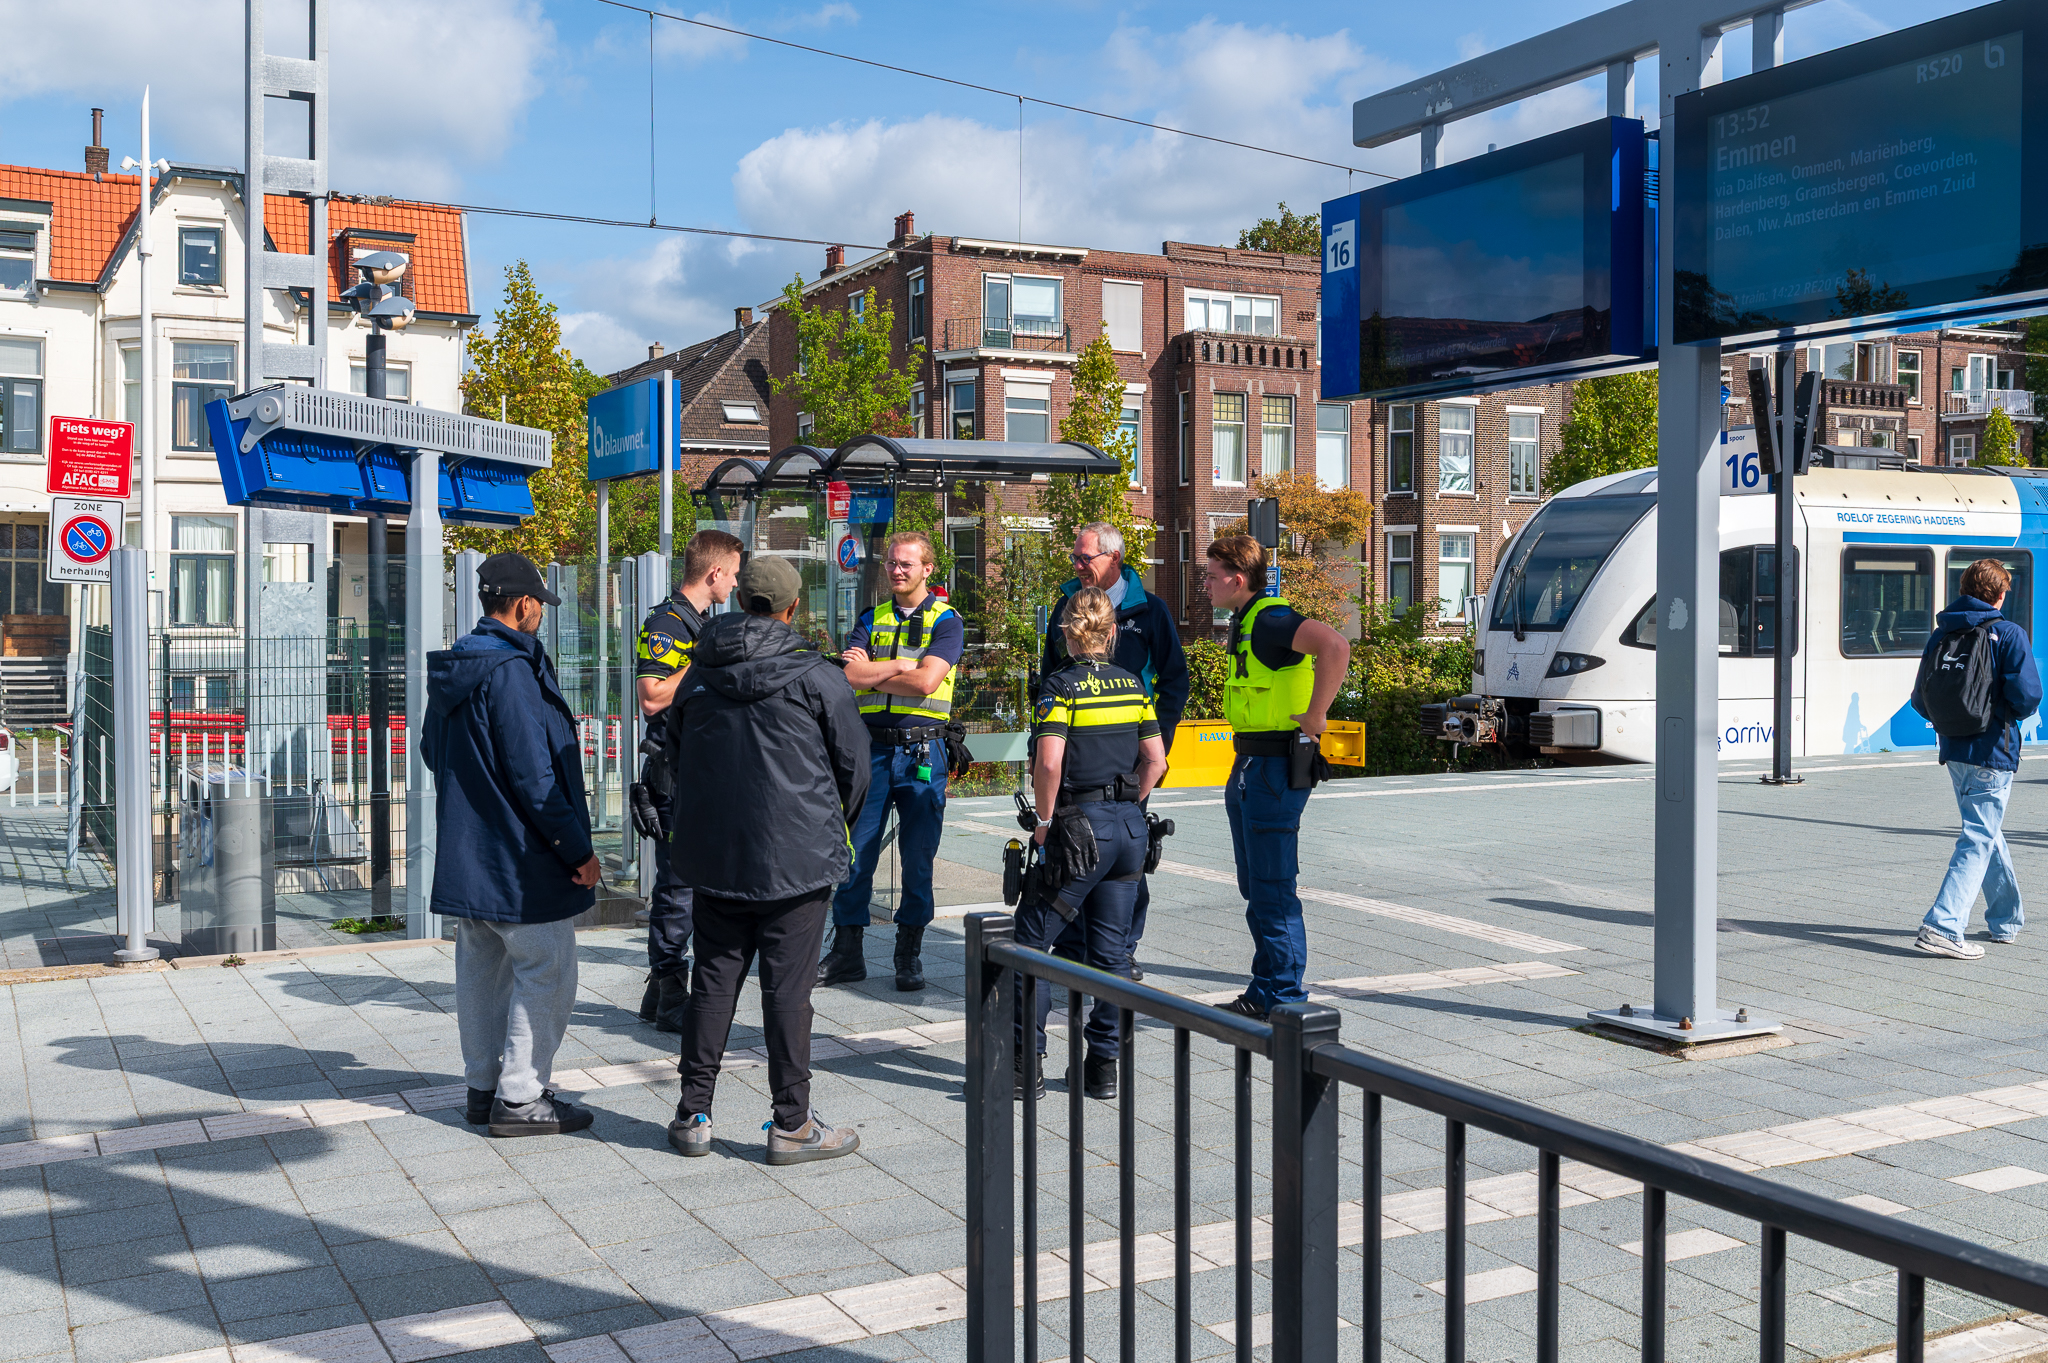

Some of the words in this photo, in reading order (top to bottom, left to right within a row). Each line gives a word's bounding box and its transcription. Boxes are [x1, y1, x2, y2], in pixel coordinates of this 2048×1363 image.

[1916, 54, 1962, 84] RS20
[1717, 104, 1770, 139] 13:52
[1717, 134, 1796, 172] Emmen
[1715, 182, 1733, 197] via
[1738, 172, 1786, 193] Dalfsen,
[1792, 158, 1845, 179] Ommen,
[1851, 136, 1936, 167] Mariënberg,
[1716, 193, 1790, 220] Hardenberg,
[1796, 172, 1889, 202] Gramsbergen,
[1894, 151, 1978, 180] Coevorden,
[1716, 223, 1753, 241] Dalen,
[1758, 217, 1780, 232] Nw.
[1784, 201, 1858, 227] Amsterdam
[1864, 196, 1879, 210] en
[1886, 184, 1938, 206] Emmen
[1943, 171, 1975, 194] Zuid
[1330, 240, 1350, 268] 16
[1742, 290, 1767, 305] train:
[1772, 284, 1800, 299] 14:22
[1804, 279, 1831, 295] RE20
[1467, 336, 1506, 351] Coevorden
[60, 422, 90, 434] Fiets
[92, 427, 125, 439] weg?
[605, 428, 644, 456] blauwnet
[62, 472, 98, 486] AFAC
[1726, 452, 1760, 488] 16
[74, 503, 102, 511] ZONE
[1837, 512, 1874, 523] ROELOF
[1876, 514, 1921, 525] ZEGERING
[1923, 516, 1966, 526] HADDERS
[60, 566, 110, 578] herhaling
[1079, 673, 1135, 695] POLITIE
[1199, 732, 1233, 742] RAWI
[1726, 722, 1774, 744] arriv
